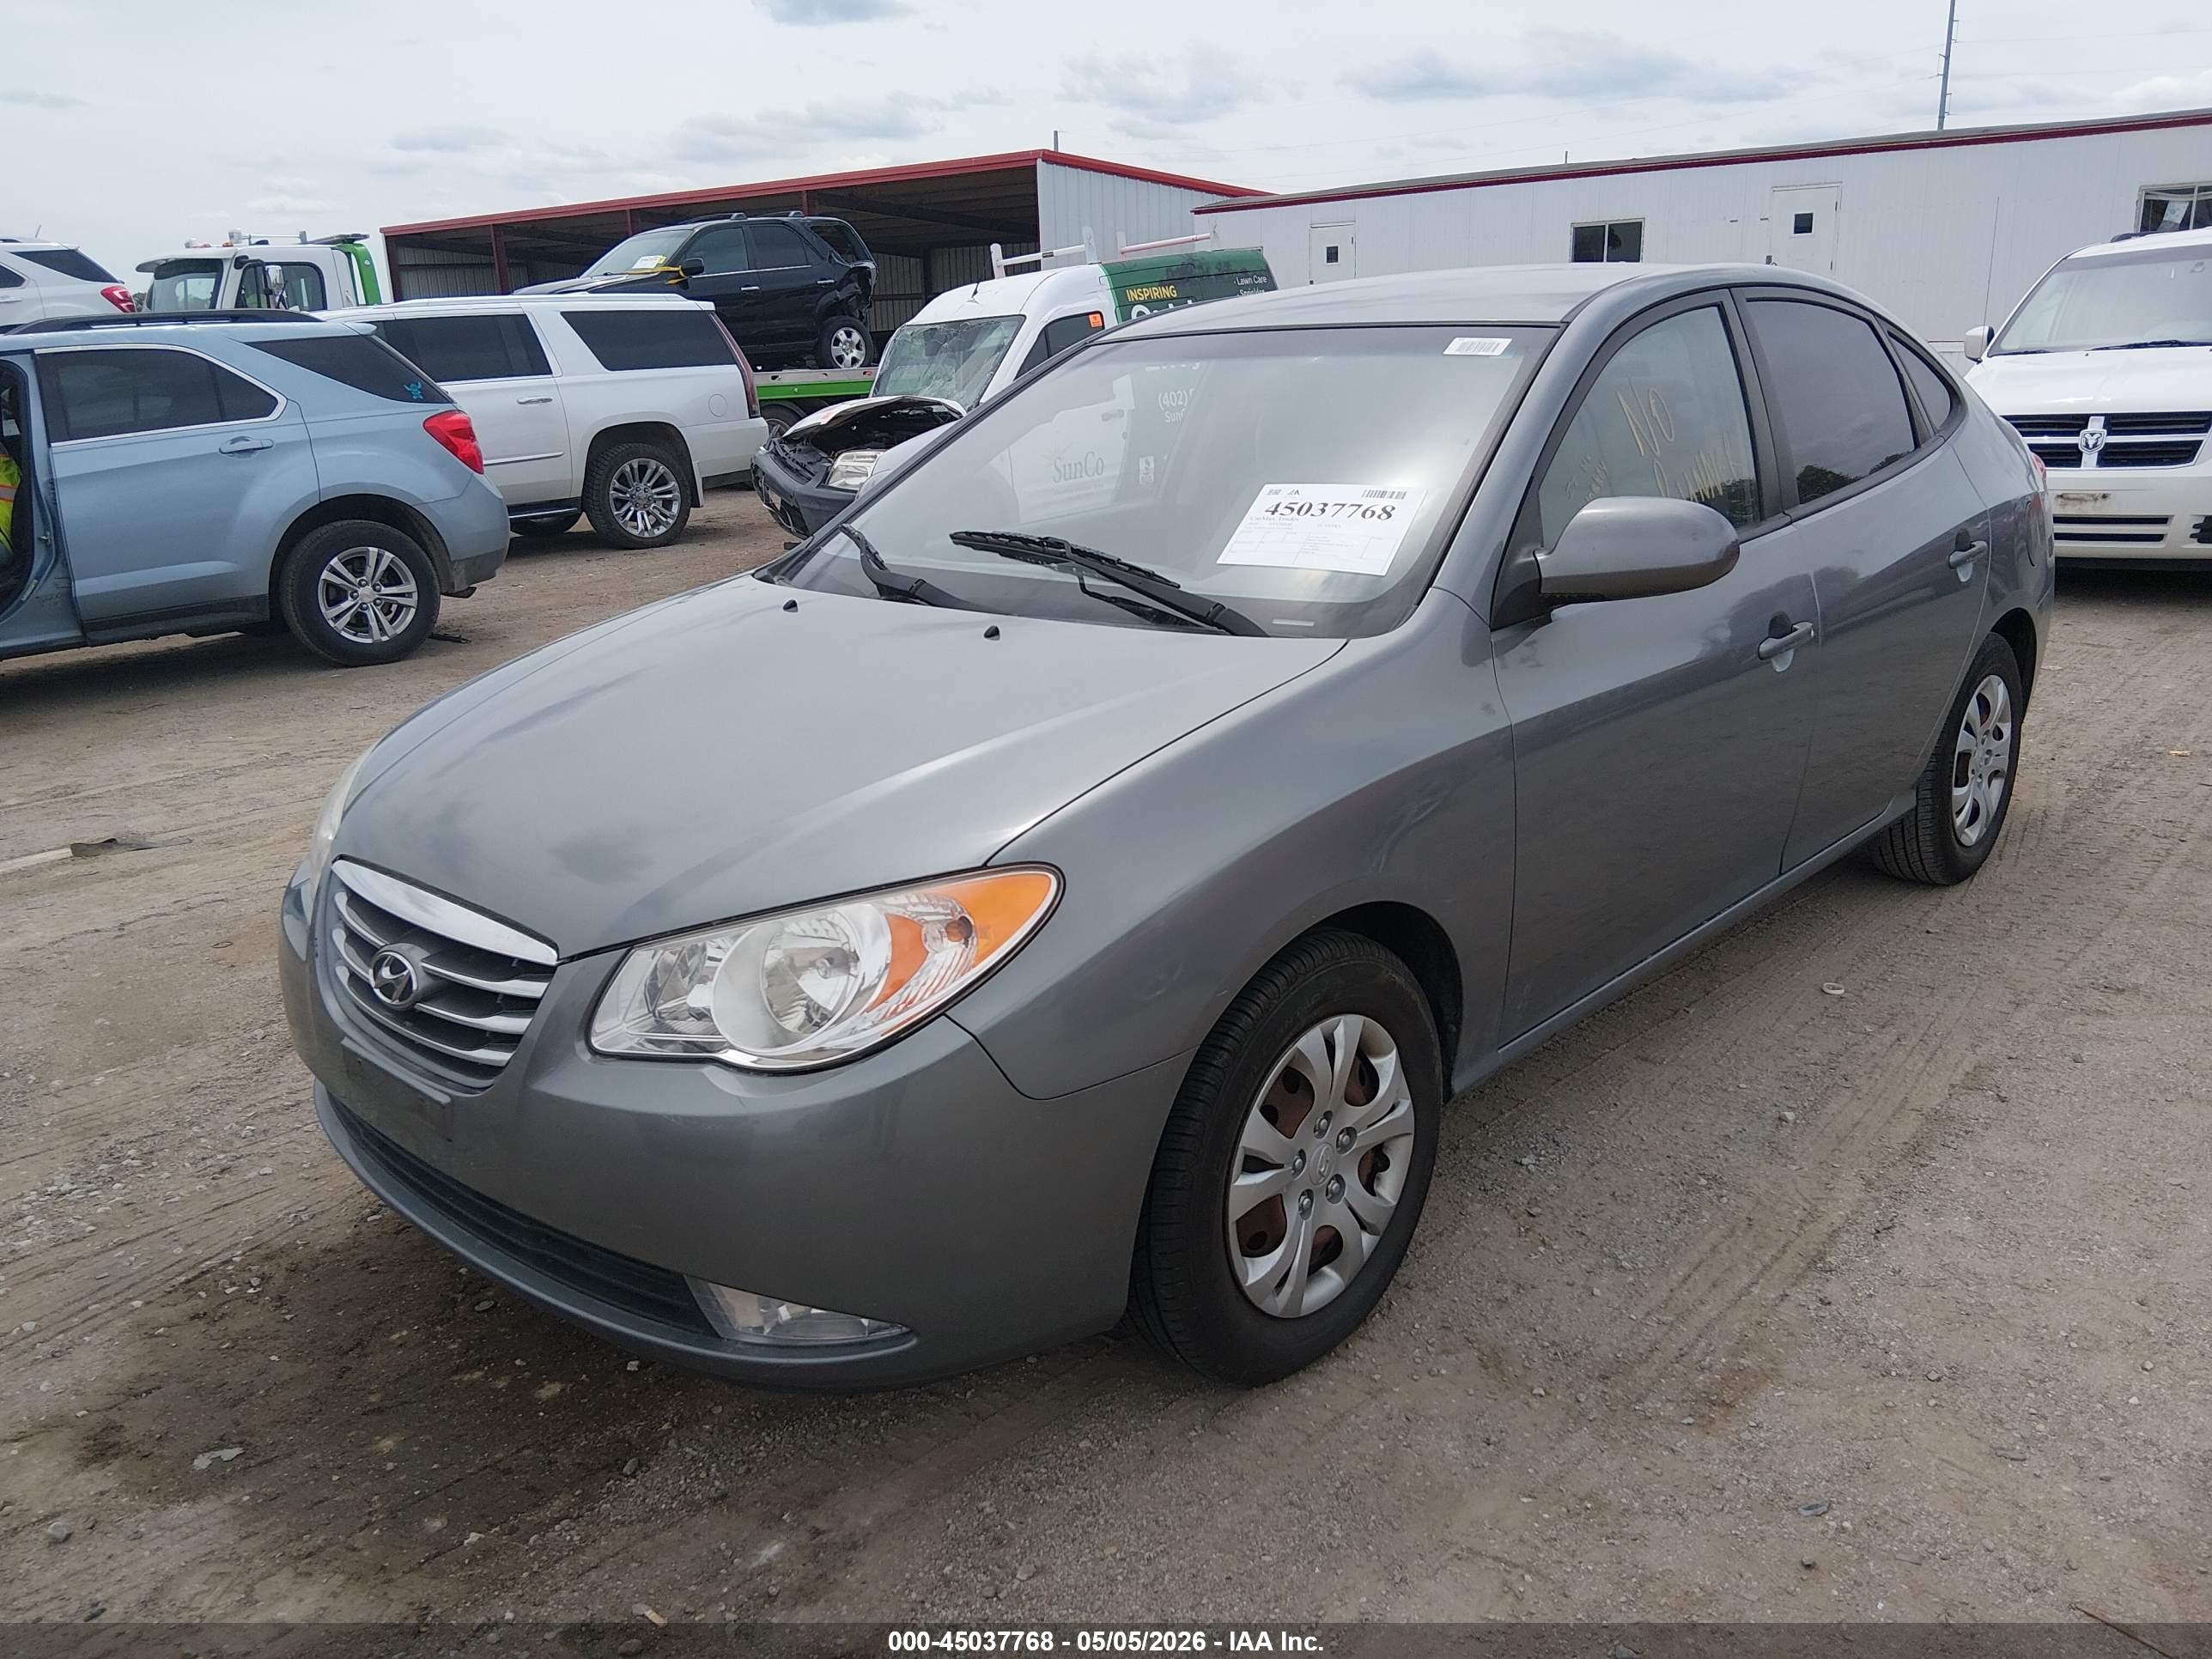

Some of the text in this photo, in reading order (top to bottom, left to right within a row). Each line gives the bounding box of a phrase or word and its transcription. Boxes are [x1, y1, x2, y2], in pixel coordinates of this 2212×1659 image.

[1237, 275, 1267, 285] Lawn Care
[1127, 285, 1177, 301] INSPIRING
[1158, 390, 1188, 410] (402)
[1616, 374, 1674, 457] NO
[1053, 451, 1104, 483] SunCo
[1265, 501, 1395, 520] 45037768
